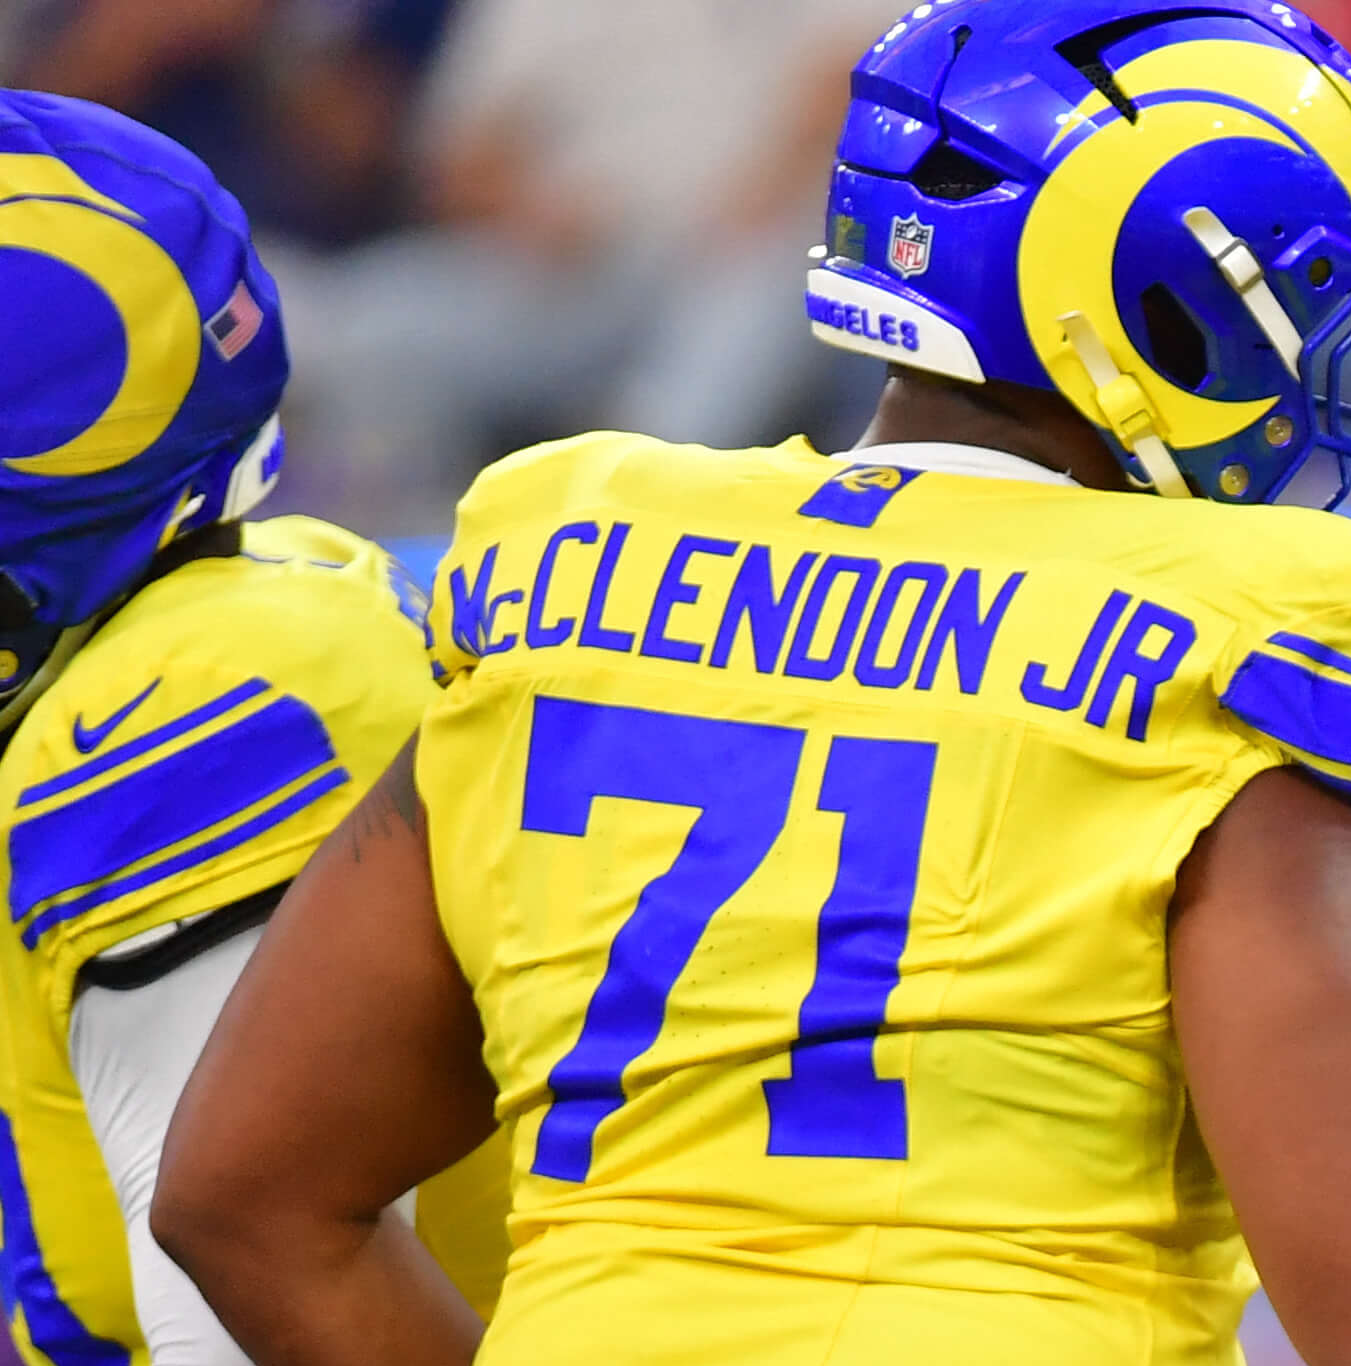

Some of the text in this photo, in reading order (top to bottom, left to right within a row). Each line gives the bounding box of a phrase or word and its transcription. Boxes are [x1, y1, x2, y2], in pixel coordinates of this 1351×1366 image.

[893, 238, 923, 267] NFL
[450, 521, 1196, 744] McCLENDON JR
[521, 695, 939, 1182] 71
